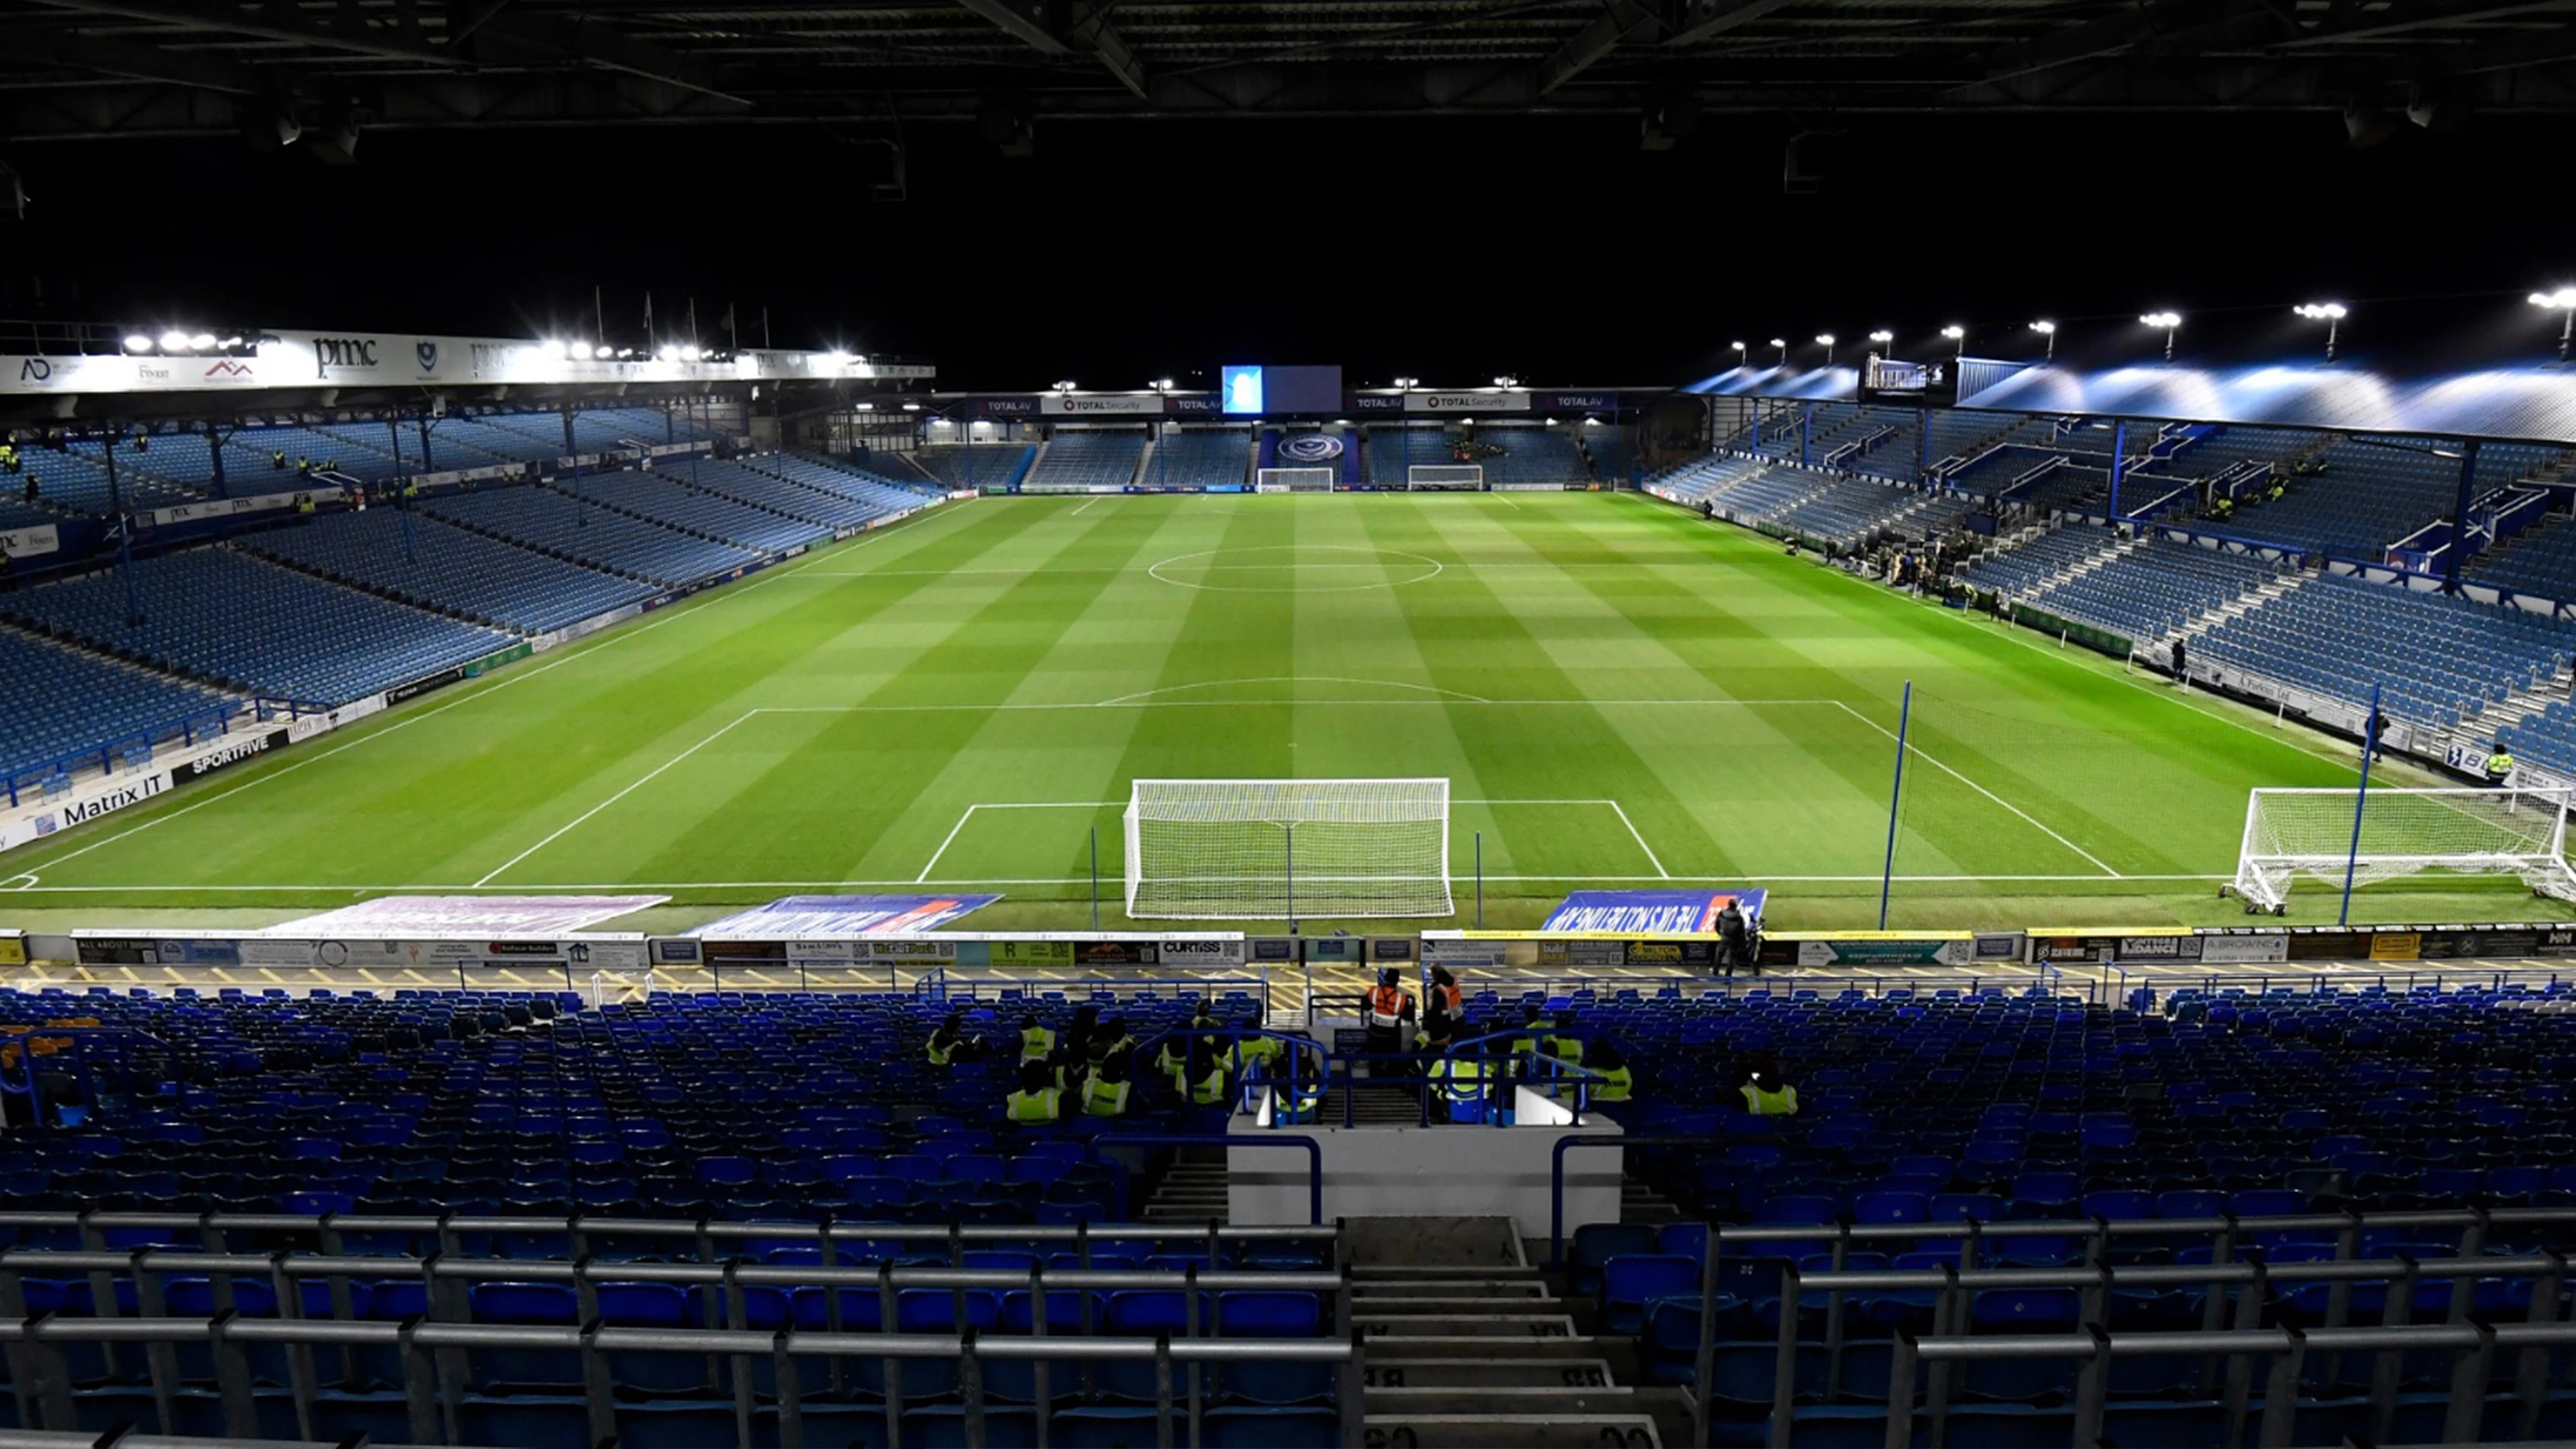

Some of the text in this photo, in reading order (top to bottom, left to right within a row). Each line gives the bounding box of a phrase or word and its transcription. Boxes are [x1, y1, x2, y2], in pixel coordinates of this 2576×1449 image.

[313, 338, 378, 379] pmc
[192, 735, 270, 773] SPORTFIVE
[64, 774, 163, 826] Matrix IT
